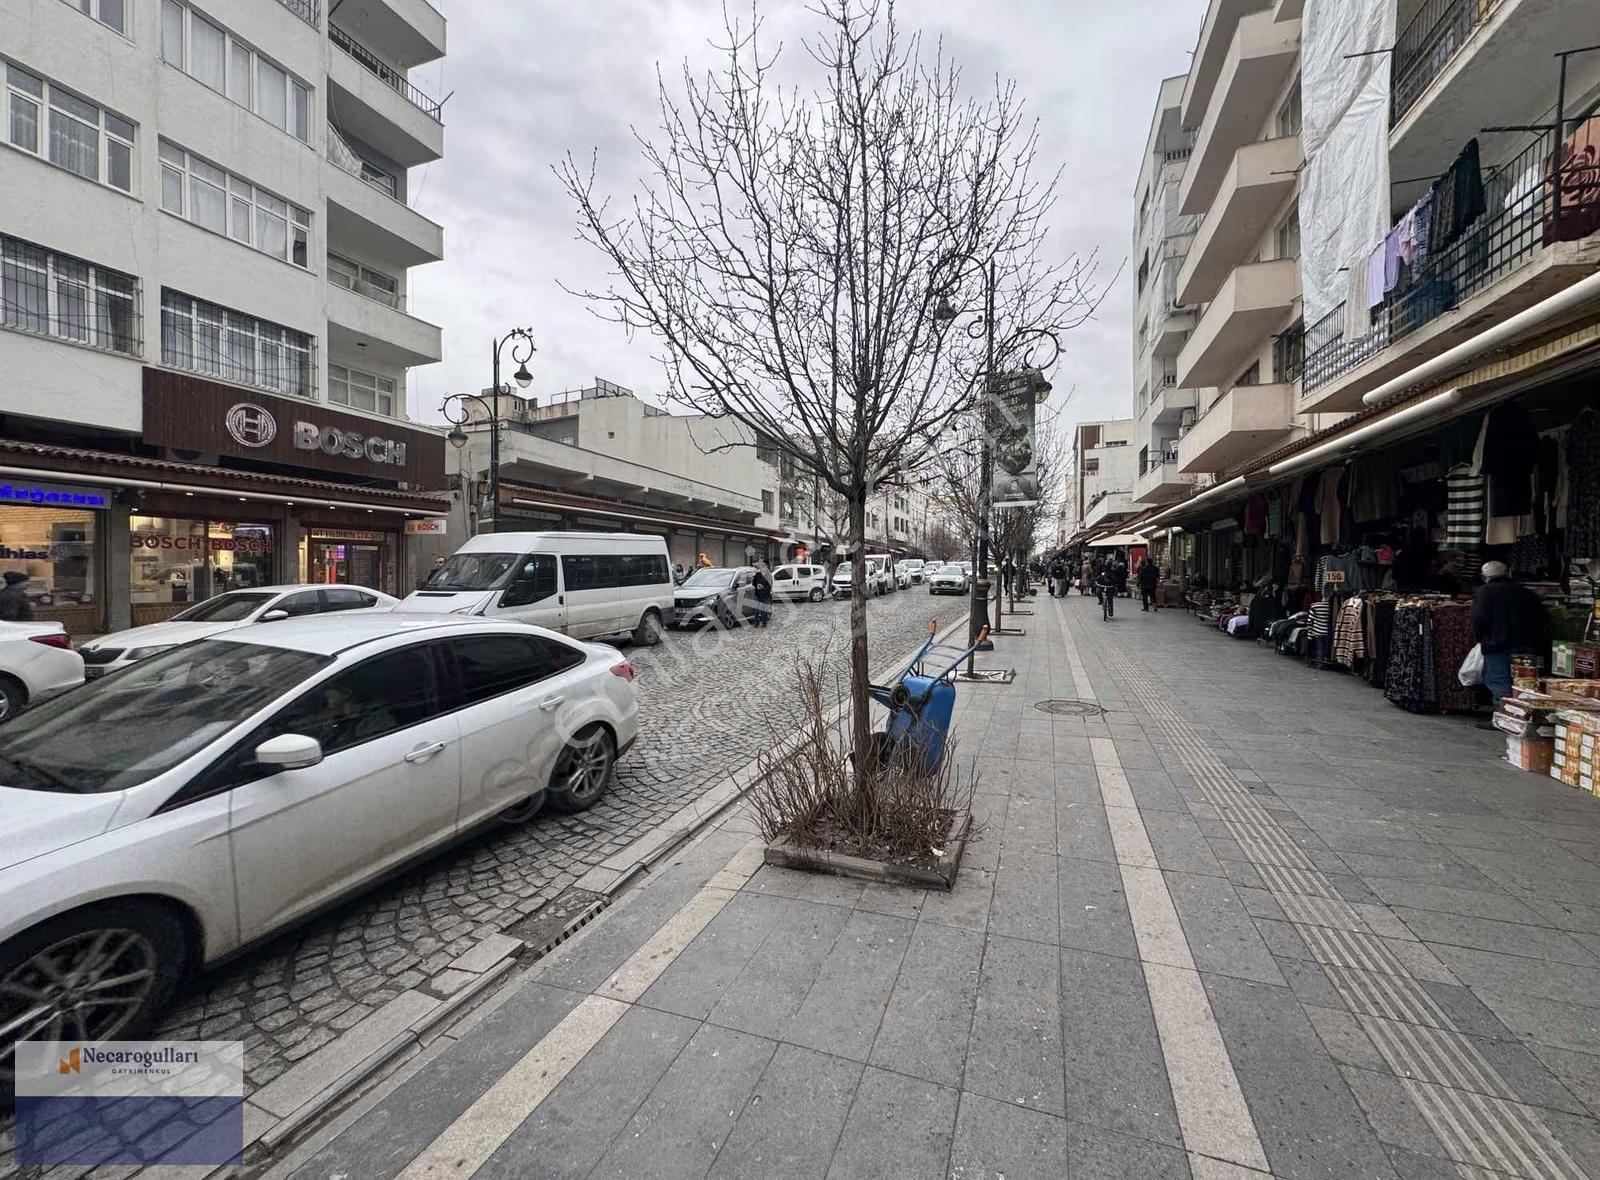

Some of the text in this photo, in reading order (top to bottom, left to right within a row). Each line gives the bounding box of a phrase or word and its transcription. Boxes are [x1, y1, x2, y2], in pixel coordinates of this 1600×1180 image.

[294, 421, 406, 466] BOSCH
[417, 523, 439, 531] BOSCH
[131, 534, 200, 550] BOSCH
[211, 538, 272, 551] BOSCH
